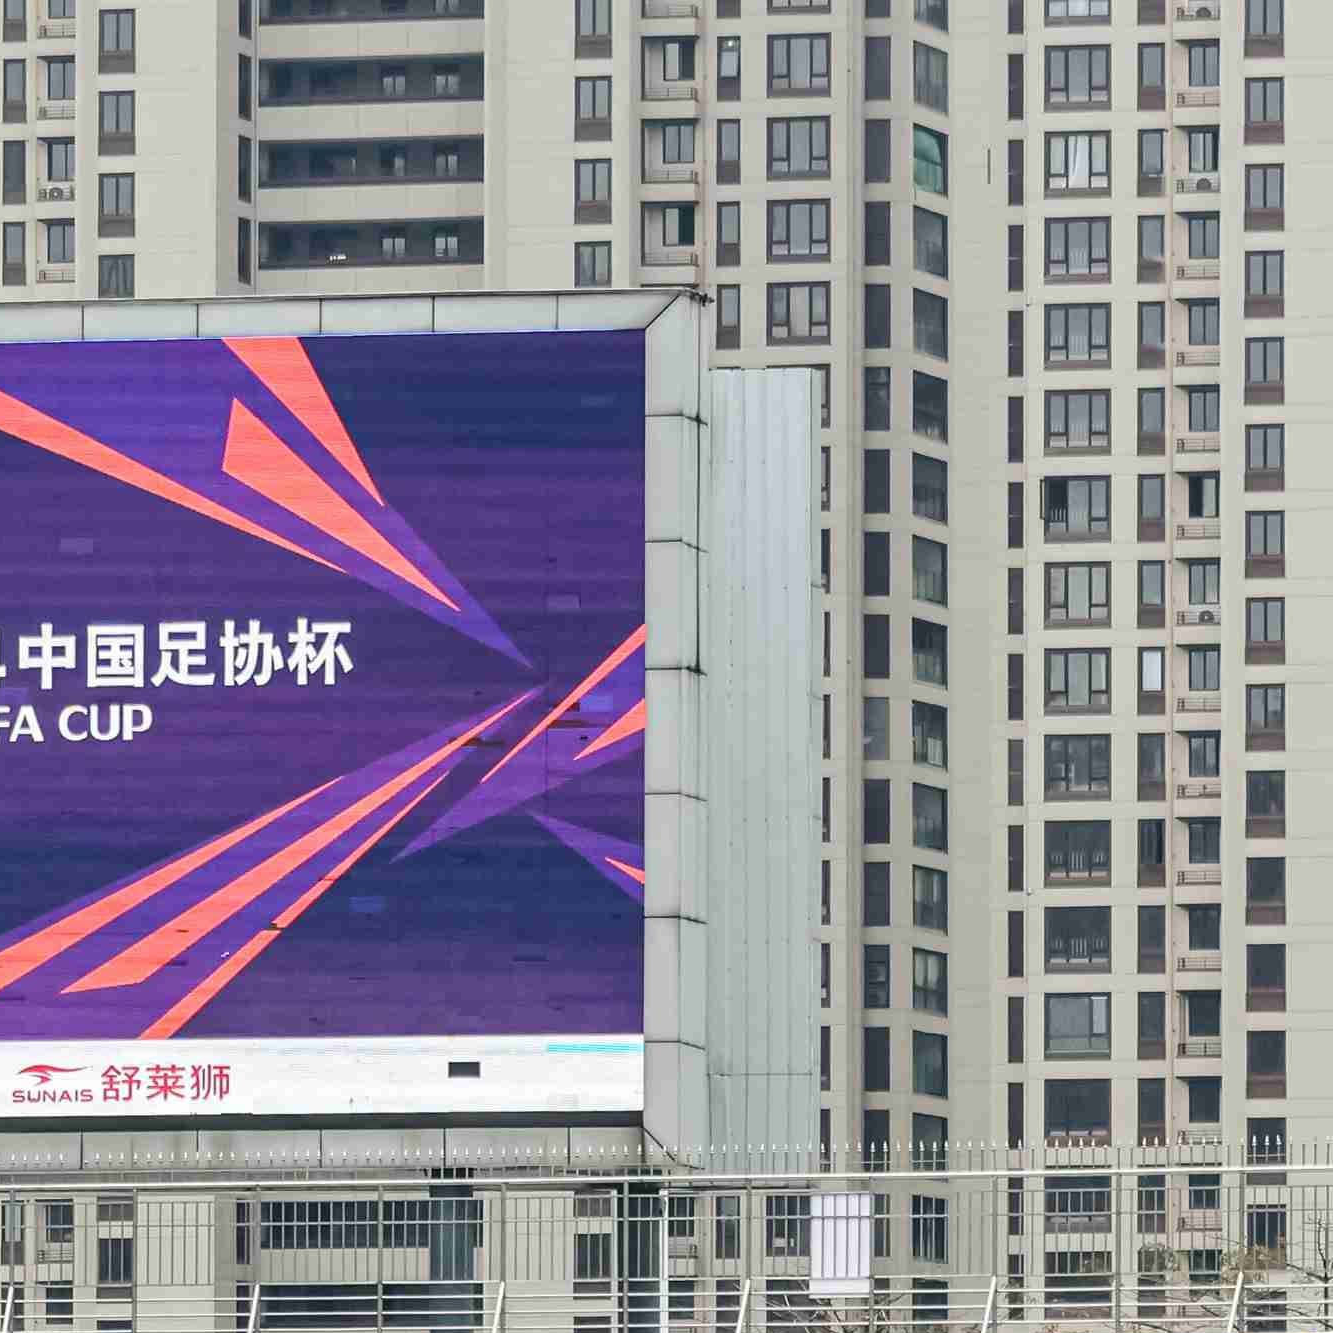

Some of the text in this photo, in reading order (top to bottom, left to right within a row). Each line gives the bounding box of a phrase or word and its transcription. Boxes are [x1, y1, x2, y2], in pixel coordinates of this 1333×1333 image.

[58, 703, 153, 741] CUP
[12, 1088, 94, 1104] SUNAIS
[100, 1064, 231, 1101] 舒莱狮
